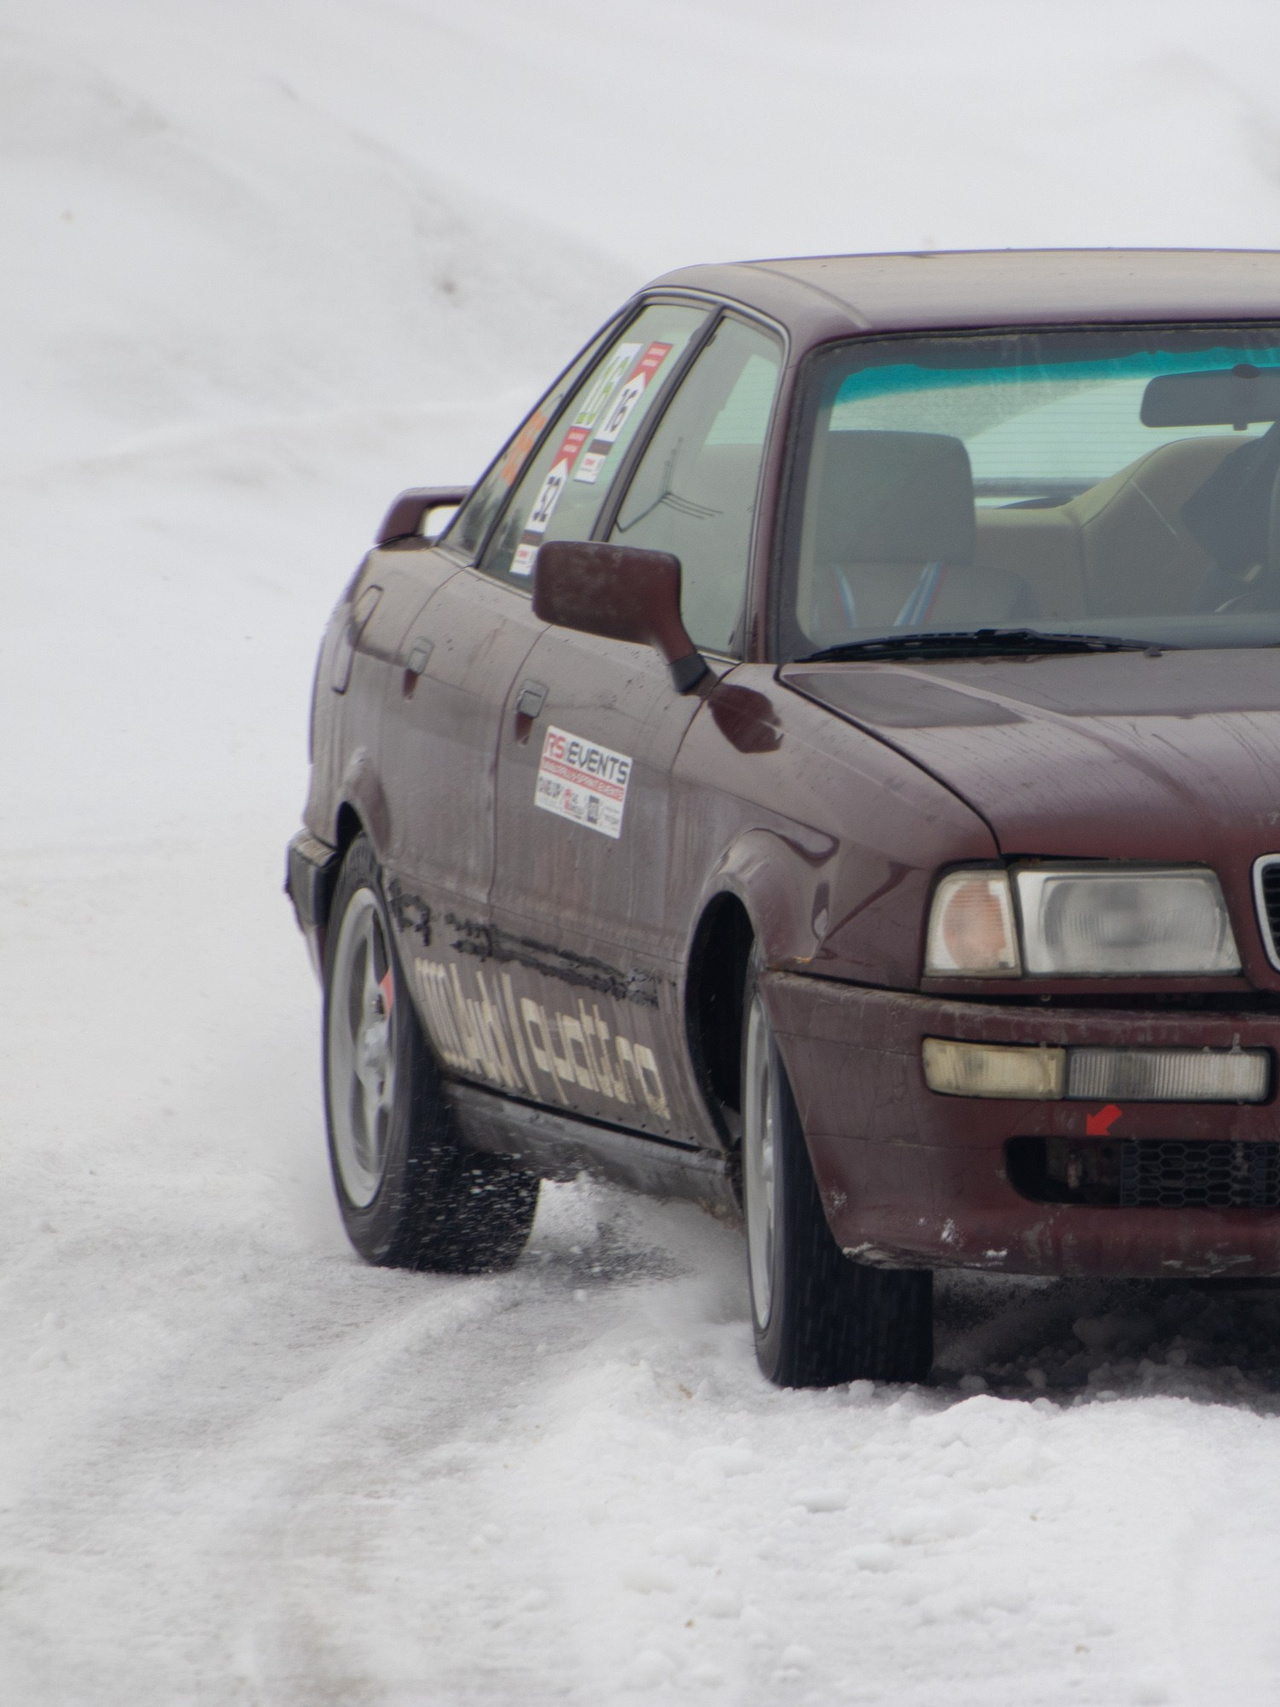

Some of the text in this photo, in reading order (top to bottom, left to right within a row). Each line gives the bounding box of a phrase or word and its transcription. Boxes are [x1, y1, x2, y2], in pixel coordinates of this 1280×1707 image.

[604, 388, 639, 432] 16
[567, 741, 629, 785] EVENTS
[520, 998, 671, 1120] quattro
